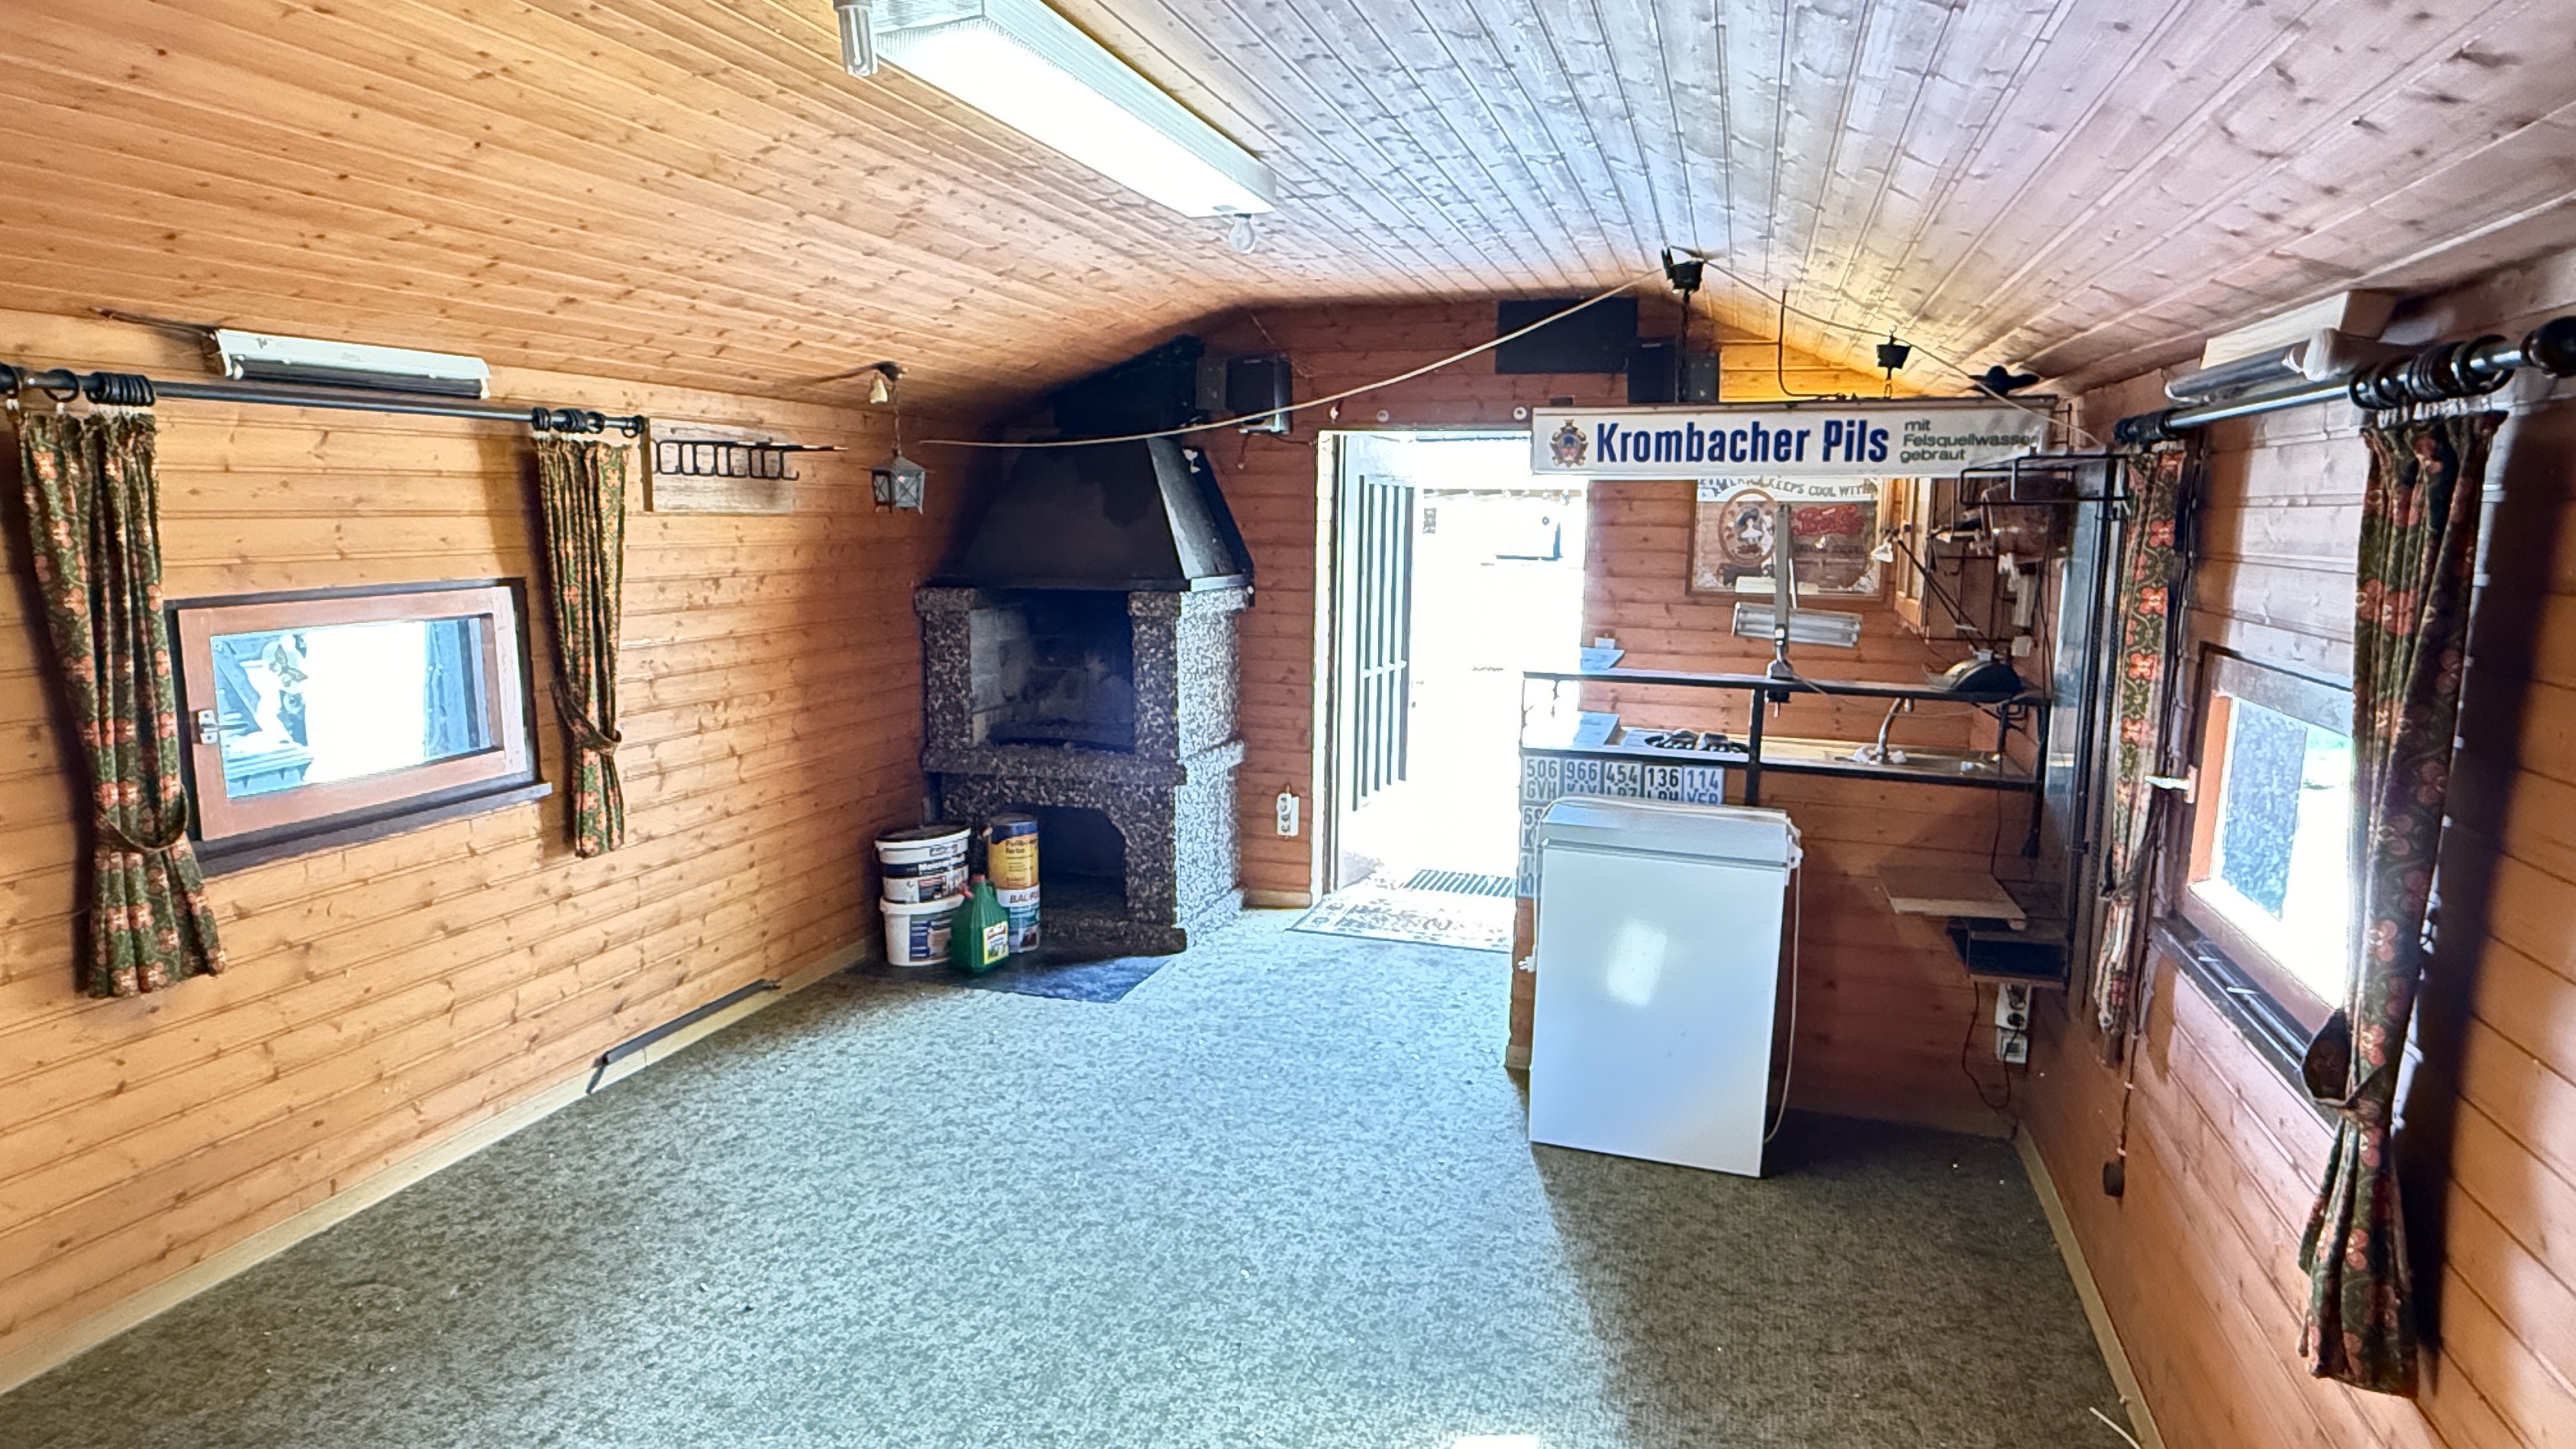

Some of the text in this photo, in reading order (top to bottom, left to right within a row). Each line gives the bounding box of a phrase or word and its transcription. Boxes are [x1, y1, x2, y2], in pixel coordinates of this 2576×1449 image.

[1905, 418, 1930, 431] mit
[1597, 419, 1889, 463] Krombacher Pils
[1900, 448, 1965, 463] gebraut
[1808, 485, 1836, 497] COOL
[1526, 759, 1558, 779] 506
[1566, 762, 1597, 781] 966
[1606, 763, 1638, 783] 454
[1648, 767, 1679, 787] 136
[1687, 769, 1719, 790] 114
